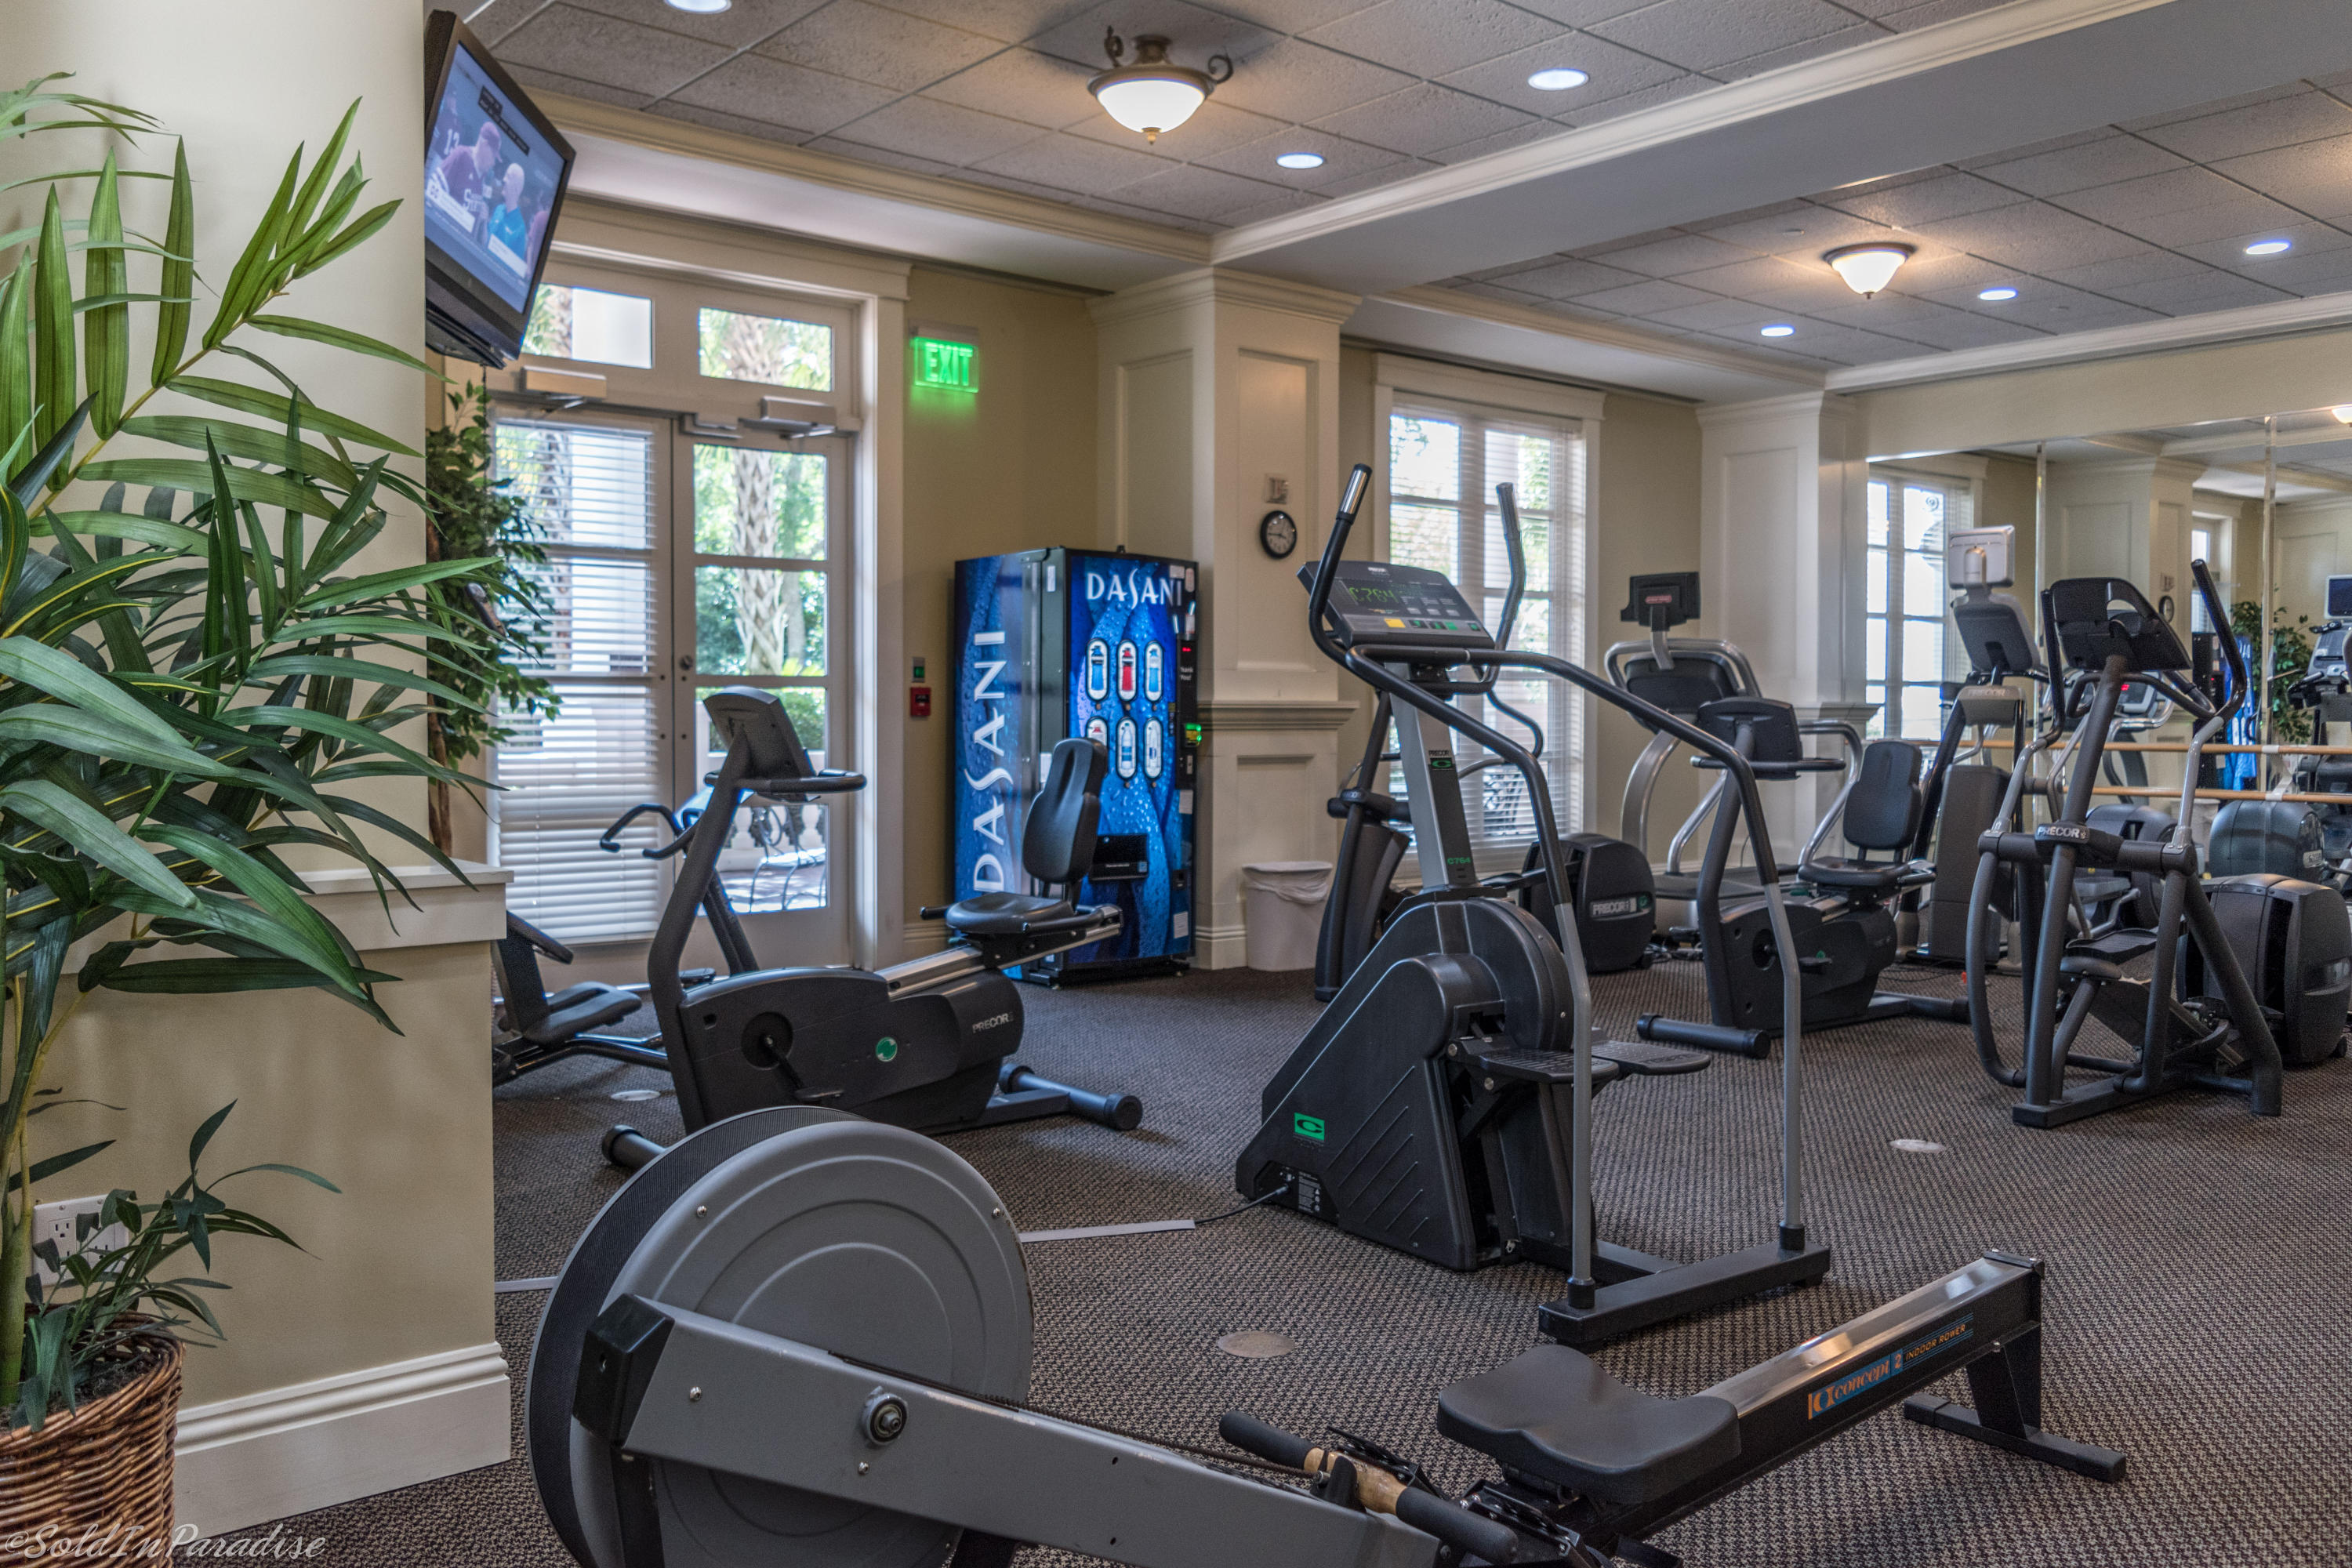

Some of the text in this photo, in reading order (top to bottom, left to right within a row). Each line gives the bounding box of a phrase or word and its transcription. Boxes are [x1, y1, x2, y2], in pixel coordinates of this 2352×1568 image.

[925, 342, 974, 386] EXIT
[1087, 568, 1182, 610] DASANI
[964, 631, 1014, 892] DASANI
[2037, 825, 2081, 839] PRECOR
[972, 1012, 1010, 1034] PRECOR
[1835, 1323, 1965, 1399] concept 2 INDOOR ROWER
